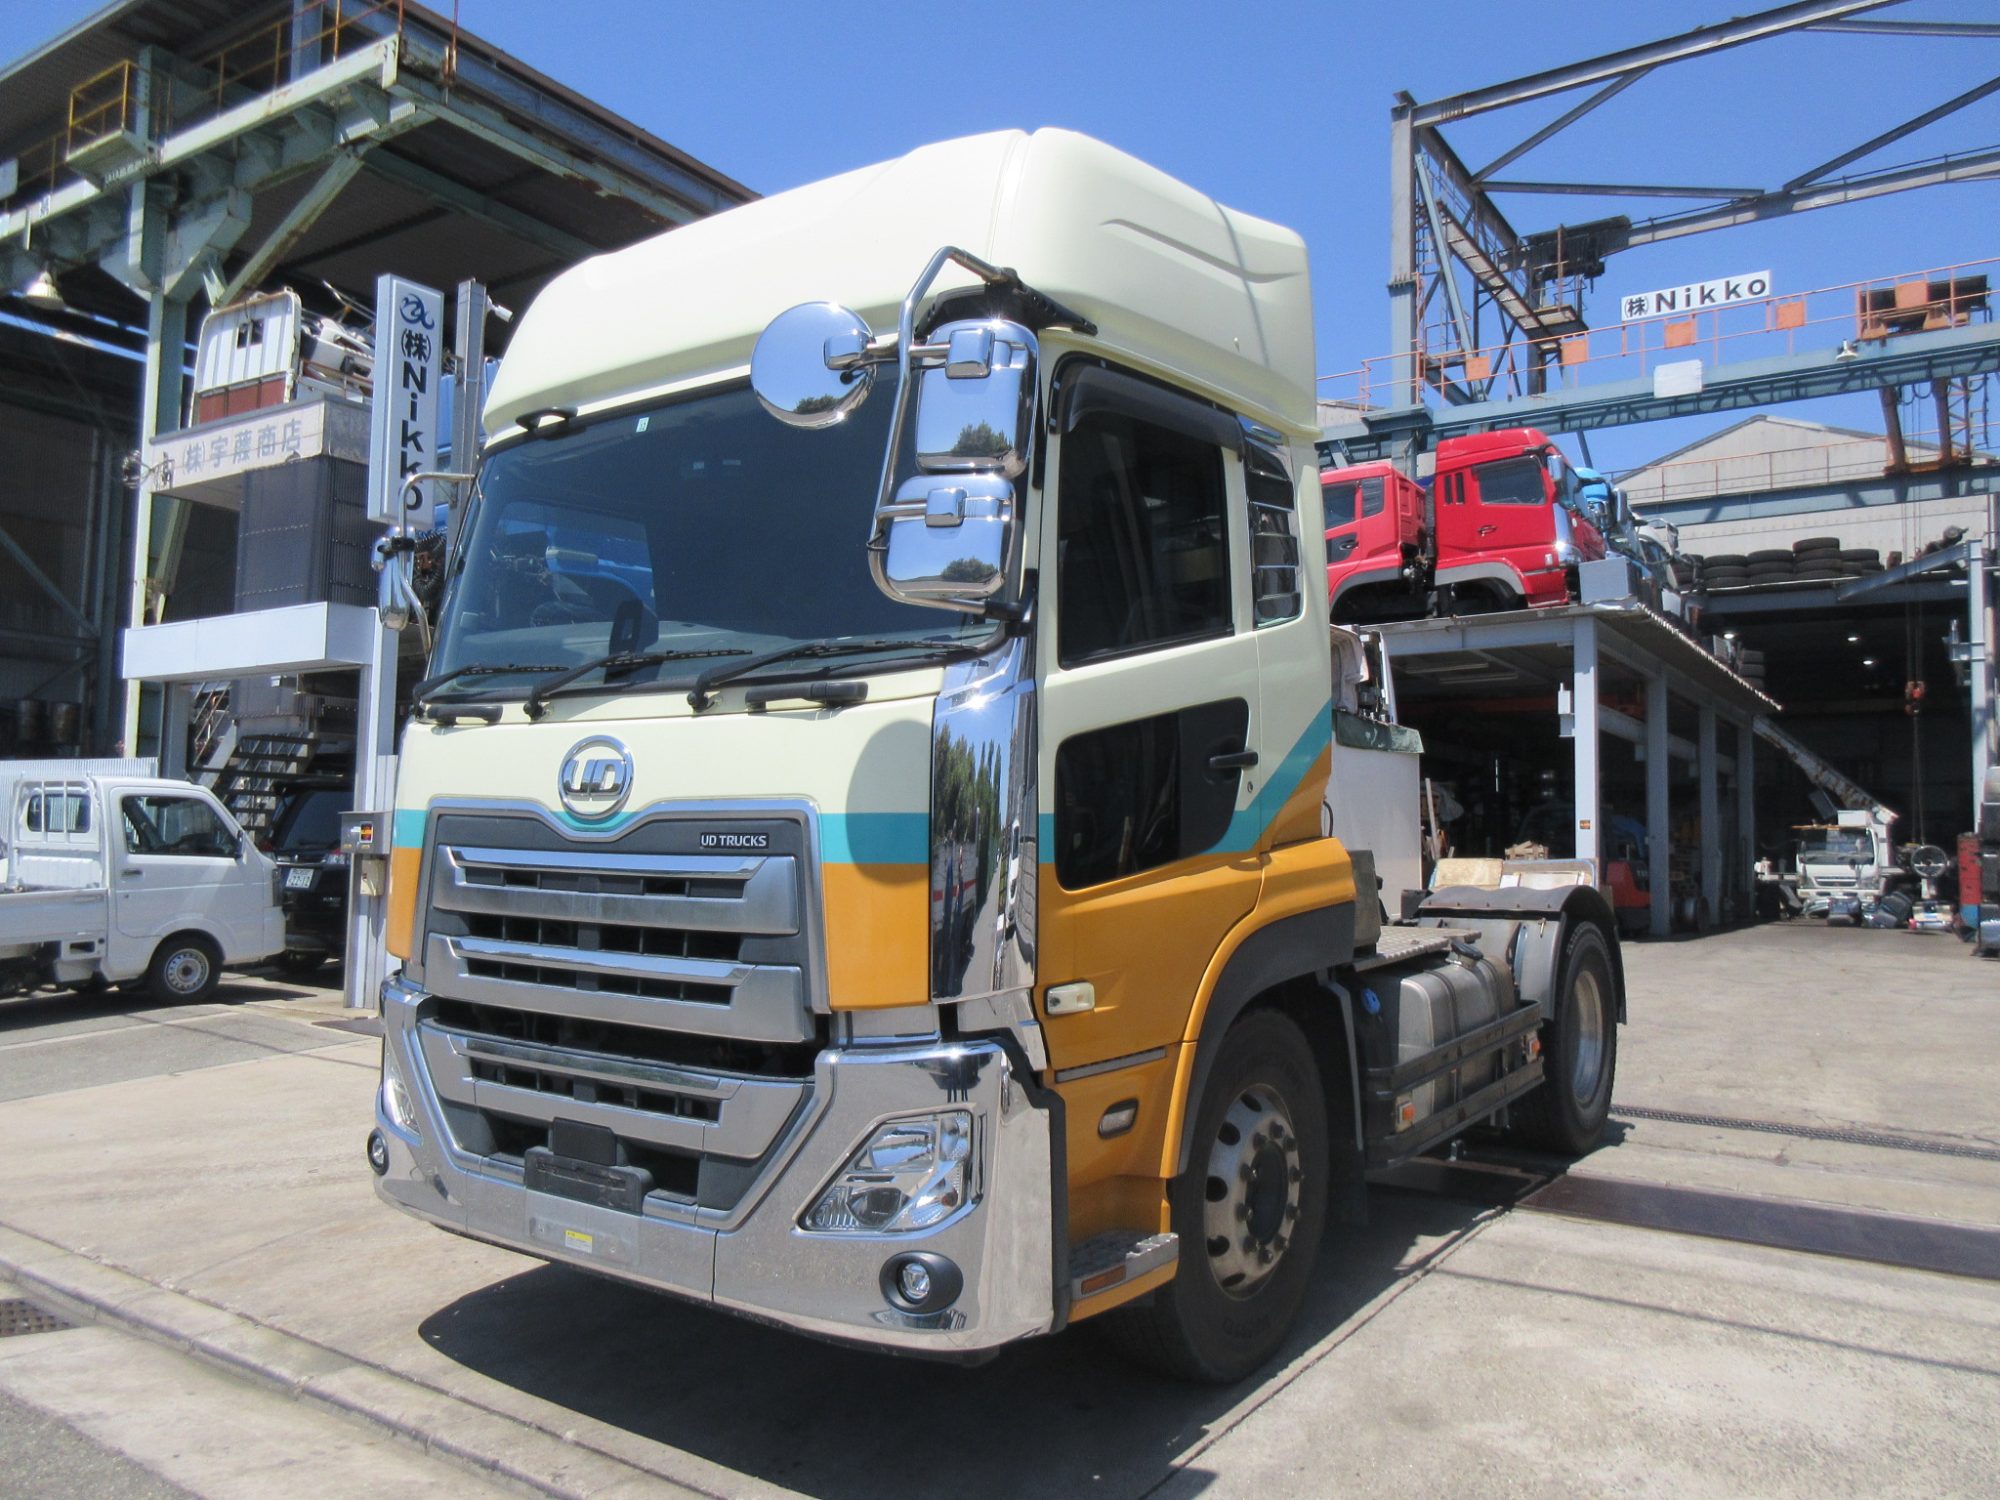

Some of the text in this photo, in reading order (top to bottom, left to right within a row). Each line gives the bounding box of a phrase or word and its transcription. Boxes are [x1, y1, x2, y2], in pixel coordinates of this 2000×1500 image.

[563, 758, 627, 801] UD
[701, 834, 767, 847] UD TRUCKS
